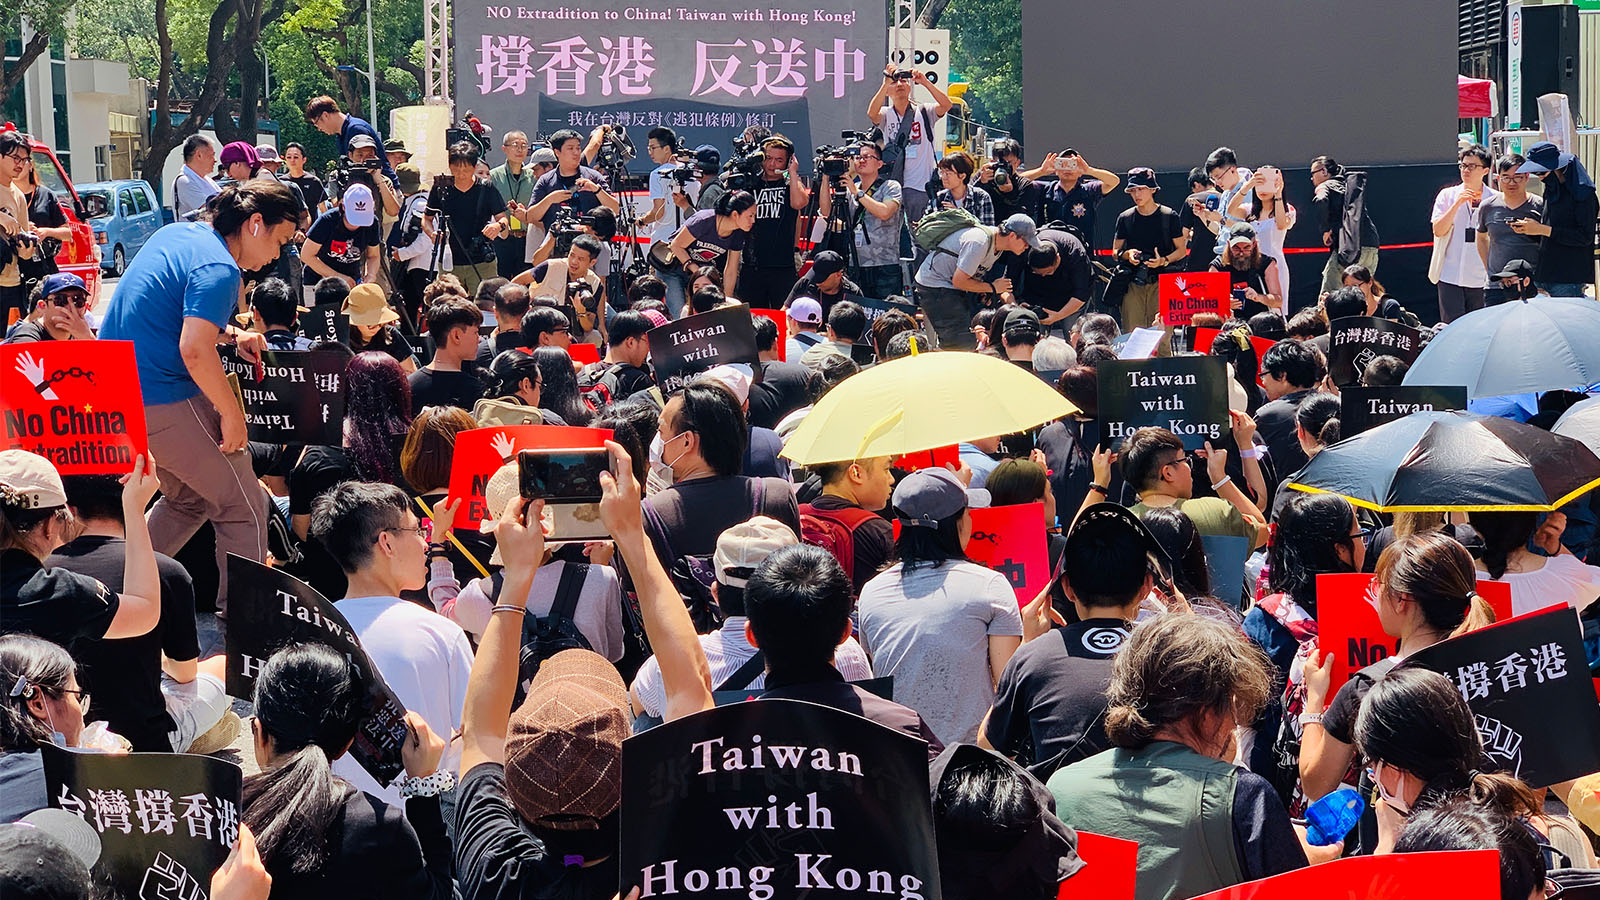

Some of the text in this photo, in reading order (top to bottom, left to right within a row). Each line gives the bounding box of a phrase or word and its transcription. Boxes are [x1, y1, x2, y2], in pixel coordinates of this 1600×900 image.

[486, 6, 856, 25] NO Extradition to China! Taiwan with Hong Kong!
[475, 34, 867, 99] 撐香港 反送中
[753, 187, 786, 204] VANS
[1169, 297, 1218, 311] No China
[325, 310, 338, 342] Kong
[669, 324, 726, 346] Taiwan
[1334, 327, 1412, 351] 台灣撐香港
[683, 343, 719, 363] with
[1127, 371, 1197, 387] Taiwan
[243, 389, 278, 405] with
[1141, 393, 1185, 412] with
[1367, 399, 1433, 414] Taiwan
[5, 404, 127, 439] No China
[245, 415, 294, 430] Taiwa
[1108, 419, 1221, 439] Ho Kong
[9, 440, 131, 466] tradition
[276, 590, 360, 649] Taiwa
[1347, 637, 1387, 667] No
[1442, 641, 1569, 702] 撐香港
[691, 734, 865, 777] Taiwan
[722, 792, 835, 831] with
[640, 853, 925, 900] Hong Kong
